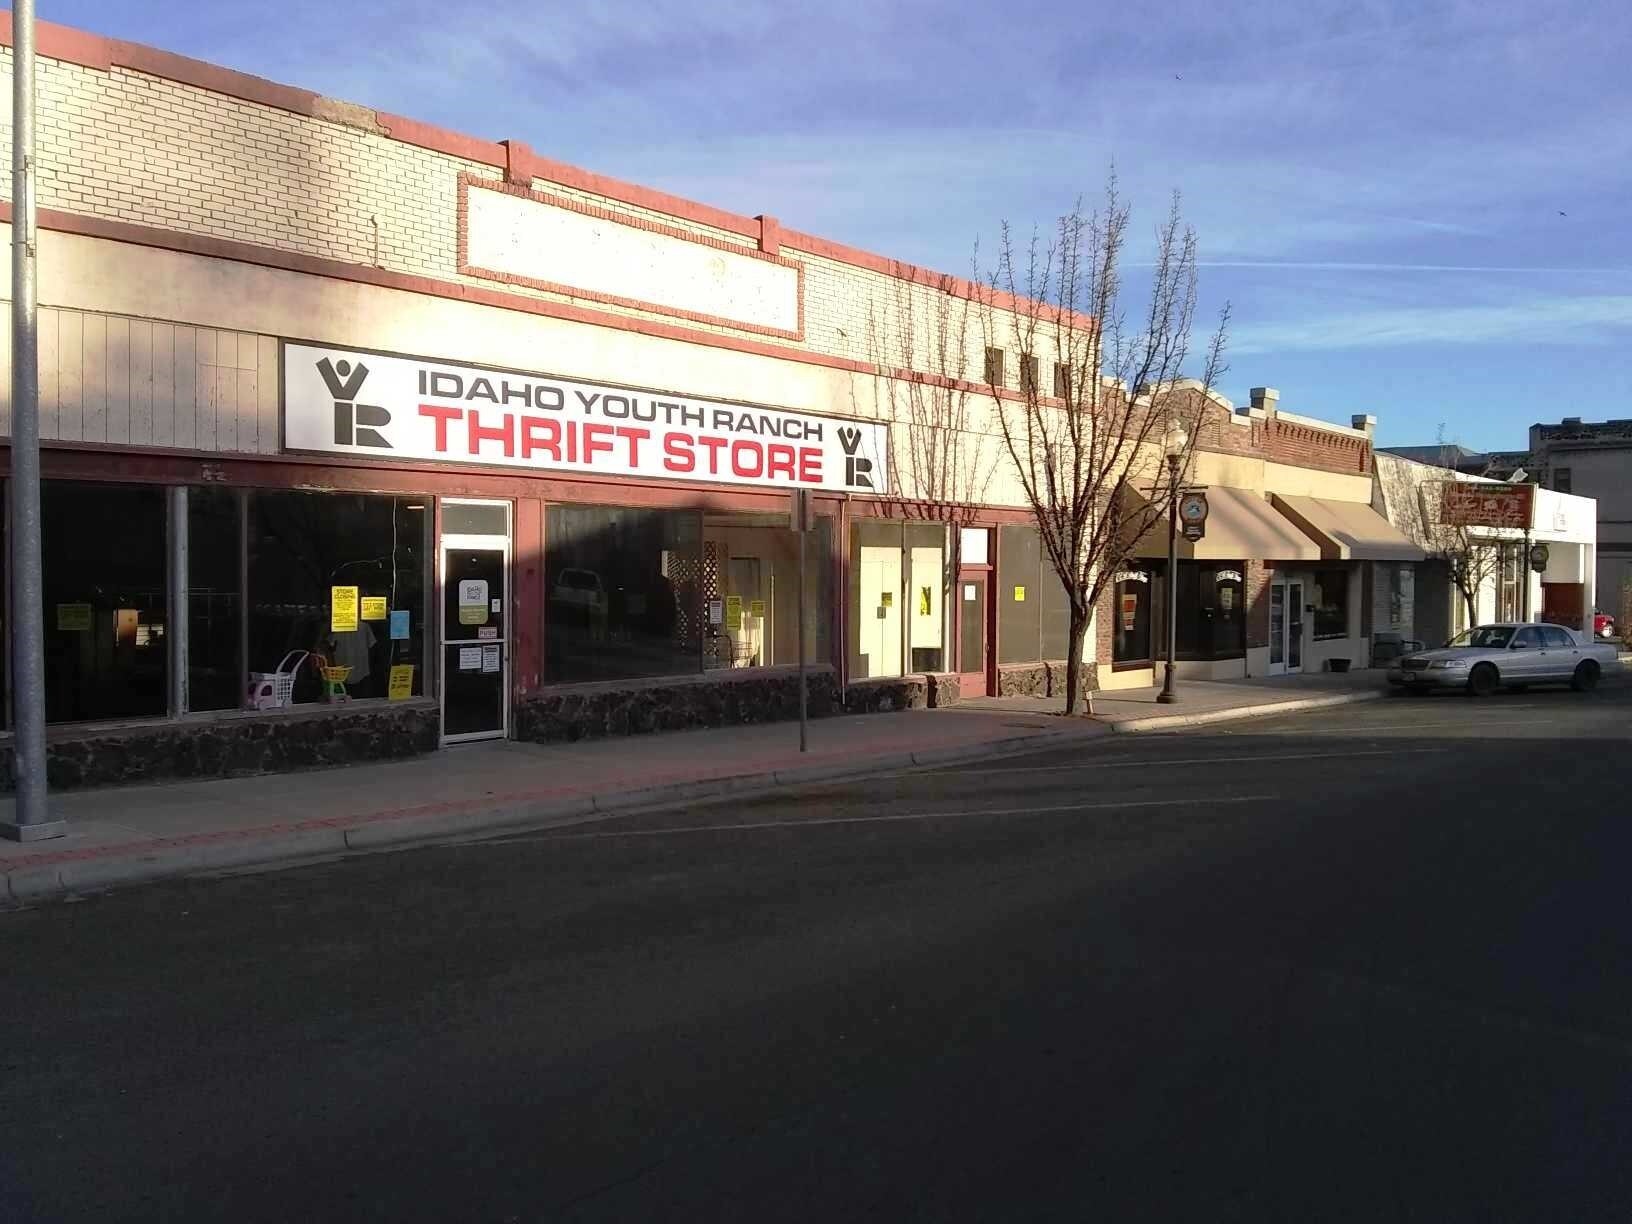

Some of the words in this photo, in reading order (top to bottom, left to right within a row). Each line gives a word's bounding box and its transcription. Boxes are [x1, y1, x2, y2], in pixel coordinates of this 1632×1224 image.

[418, 369, 564, 411] IDAHO
[574, 390, 705, 428] YOUTH
[713, 409, 823, 442] RANCH
[418, 403, 650, 468] THRIFT
[663, 431, 823, 483] STORE
